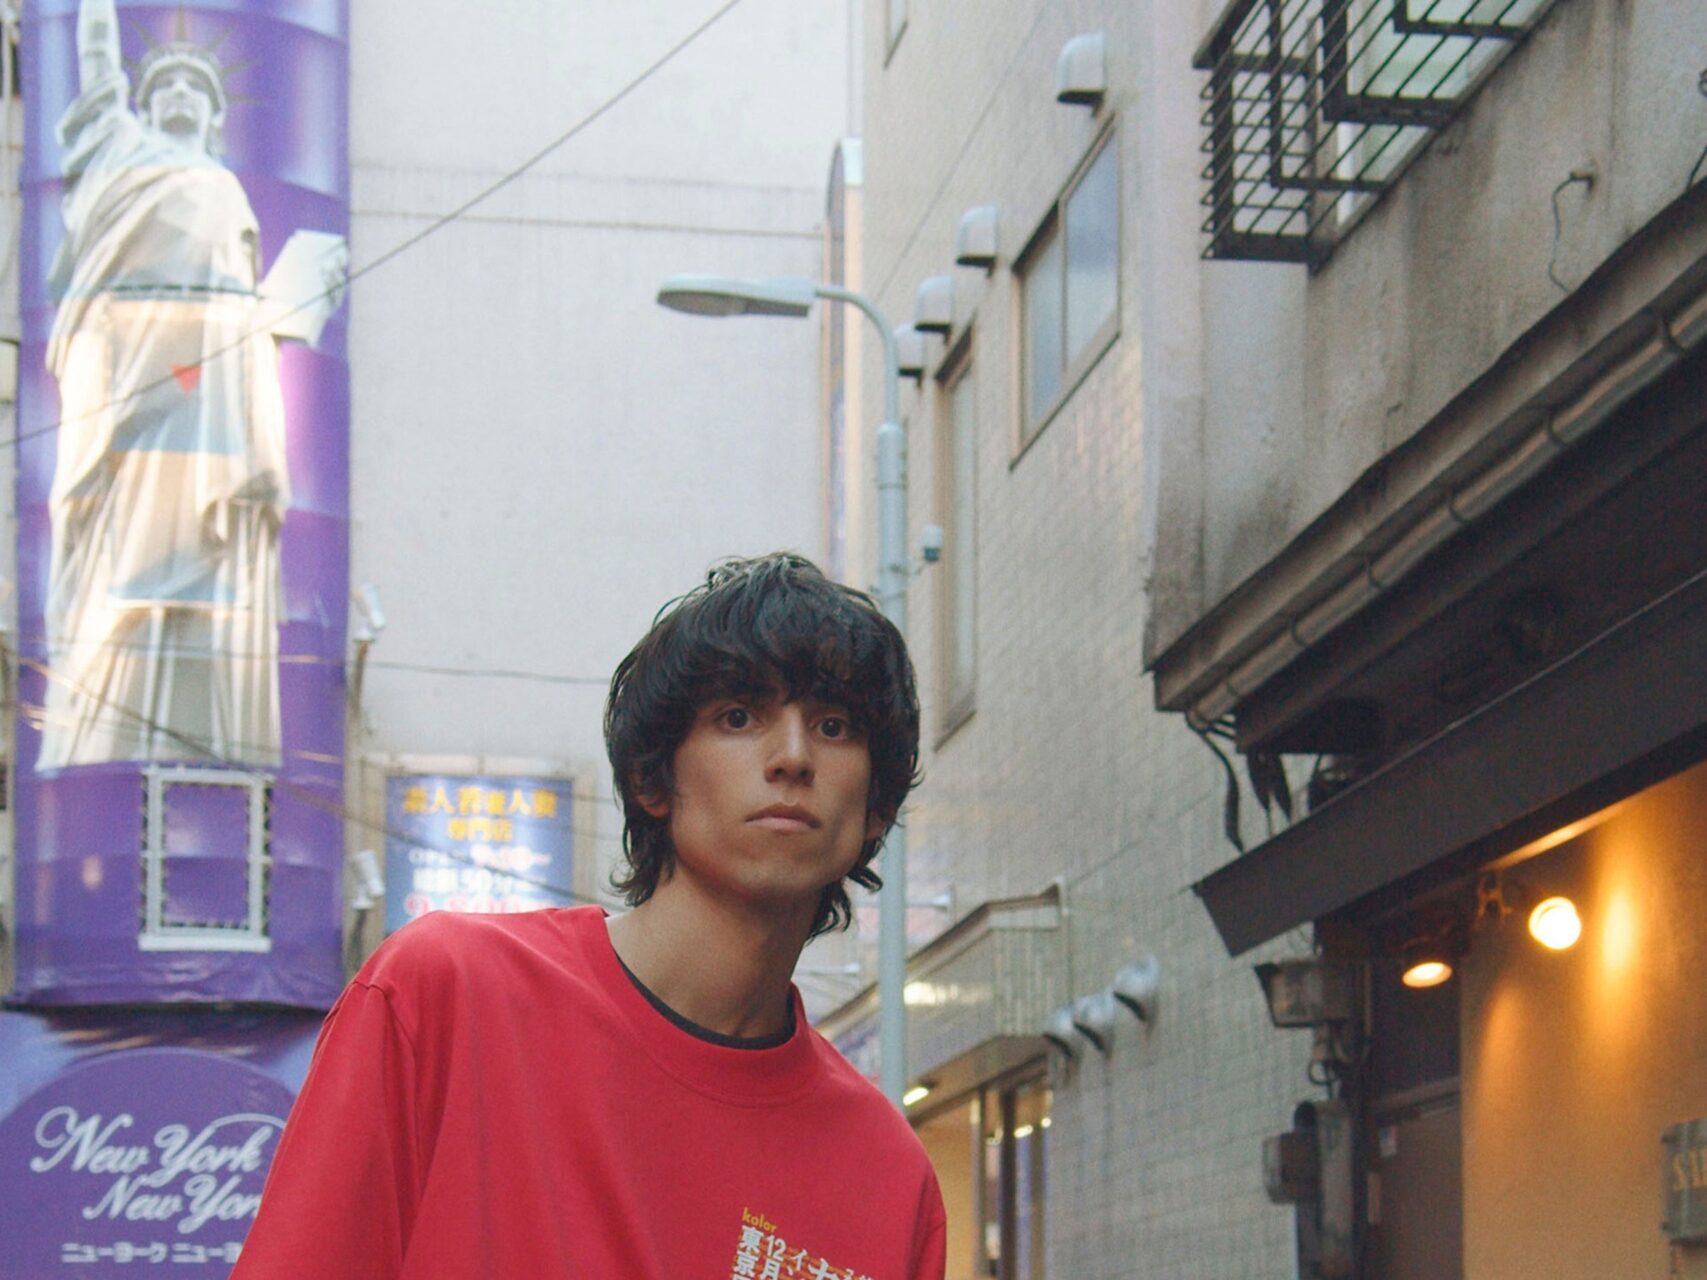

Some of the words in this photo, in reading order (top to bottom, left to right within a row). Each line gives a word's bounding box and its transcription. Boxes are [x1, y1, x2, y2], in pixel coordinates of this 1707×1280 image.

[30, 1105, 149, 1173] New
[146, 1113, 286, 1187] York
[82, 1173, 183, 1220] New
[177, 1173, 262, 1234] Yor
[742, 1207, 777, 1233] kolor
[61, 1242, 168, 1263] ニューヨーク
[172, 1242, 244, 1263] ニューヨ
